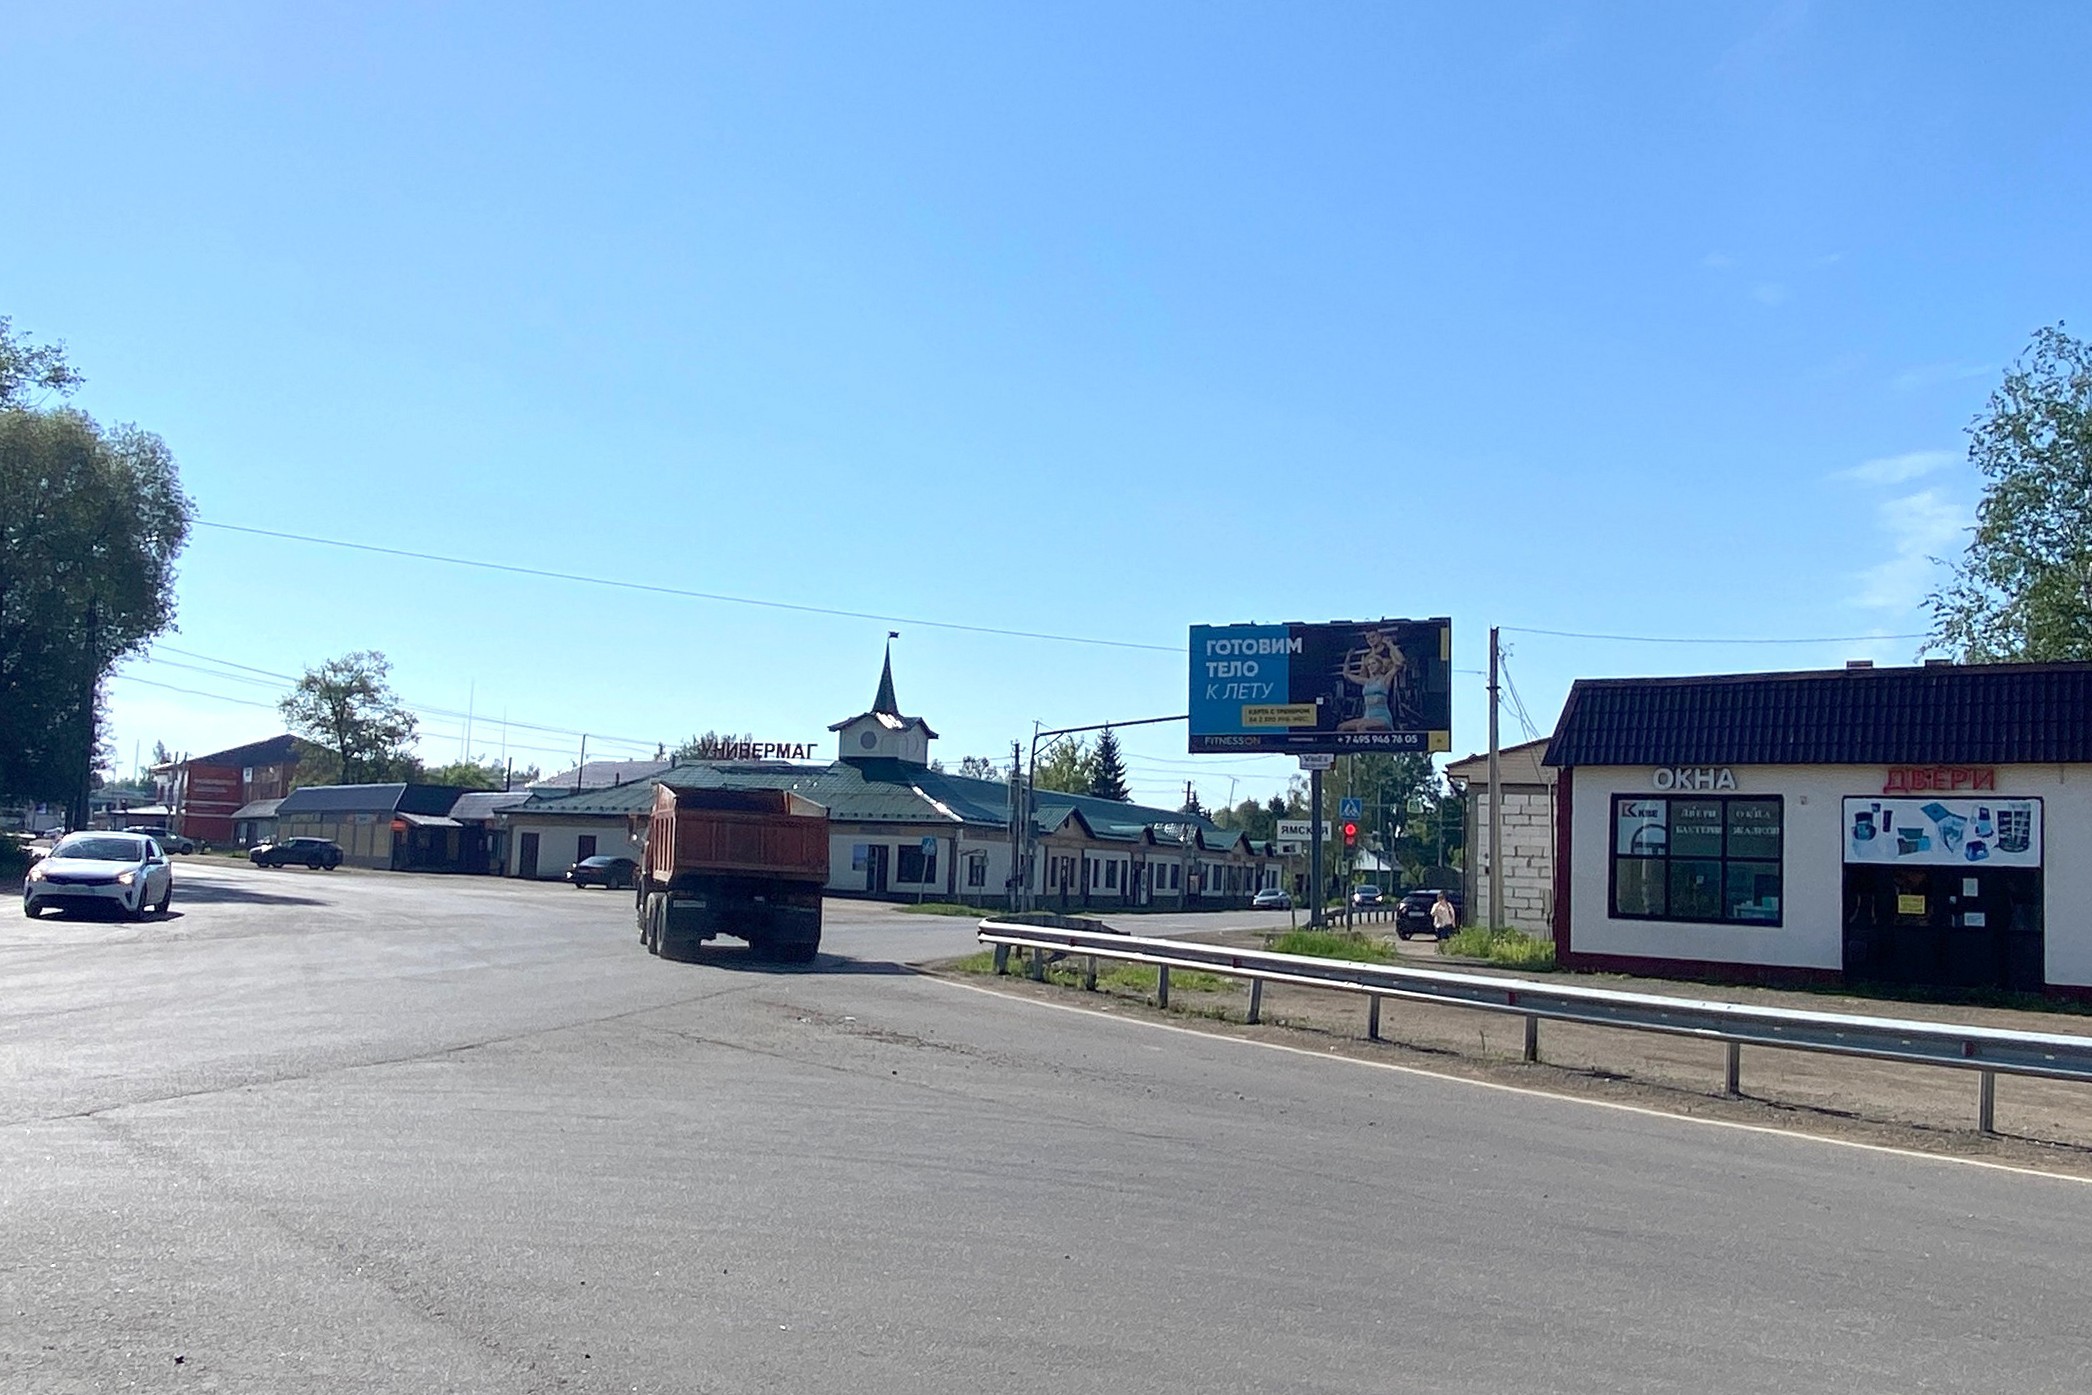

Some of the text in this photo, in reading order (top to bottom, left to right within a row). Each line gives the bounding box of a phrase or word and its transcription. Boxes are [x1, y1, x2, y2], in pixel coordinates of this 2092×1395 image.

[1206, 638, 1302, 655] ГОТОВИМ
[1206, 661, 1258, 677] ТЕЛО
[1206, 682, 1274, 699] К ЛЕТУ
[1345, 735, 1352, 744] 7
[1353, 735, 1370, 744] 495
[1404, 735, 1418, 744] 05
[702, 742, 818, 760] УНИВЕРМАГ
[1653, 768, 1737, 790] ОКНА
[1883, 768, 1995, 793] ДВЕРИ
[1282, 825, 1328, 835] ЯМСКЯ
